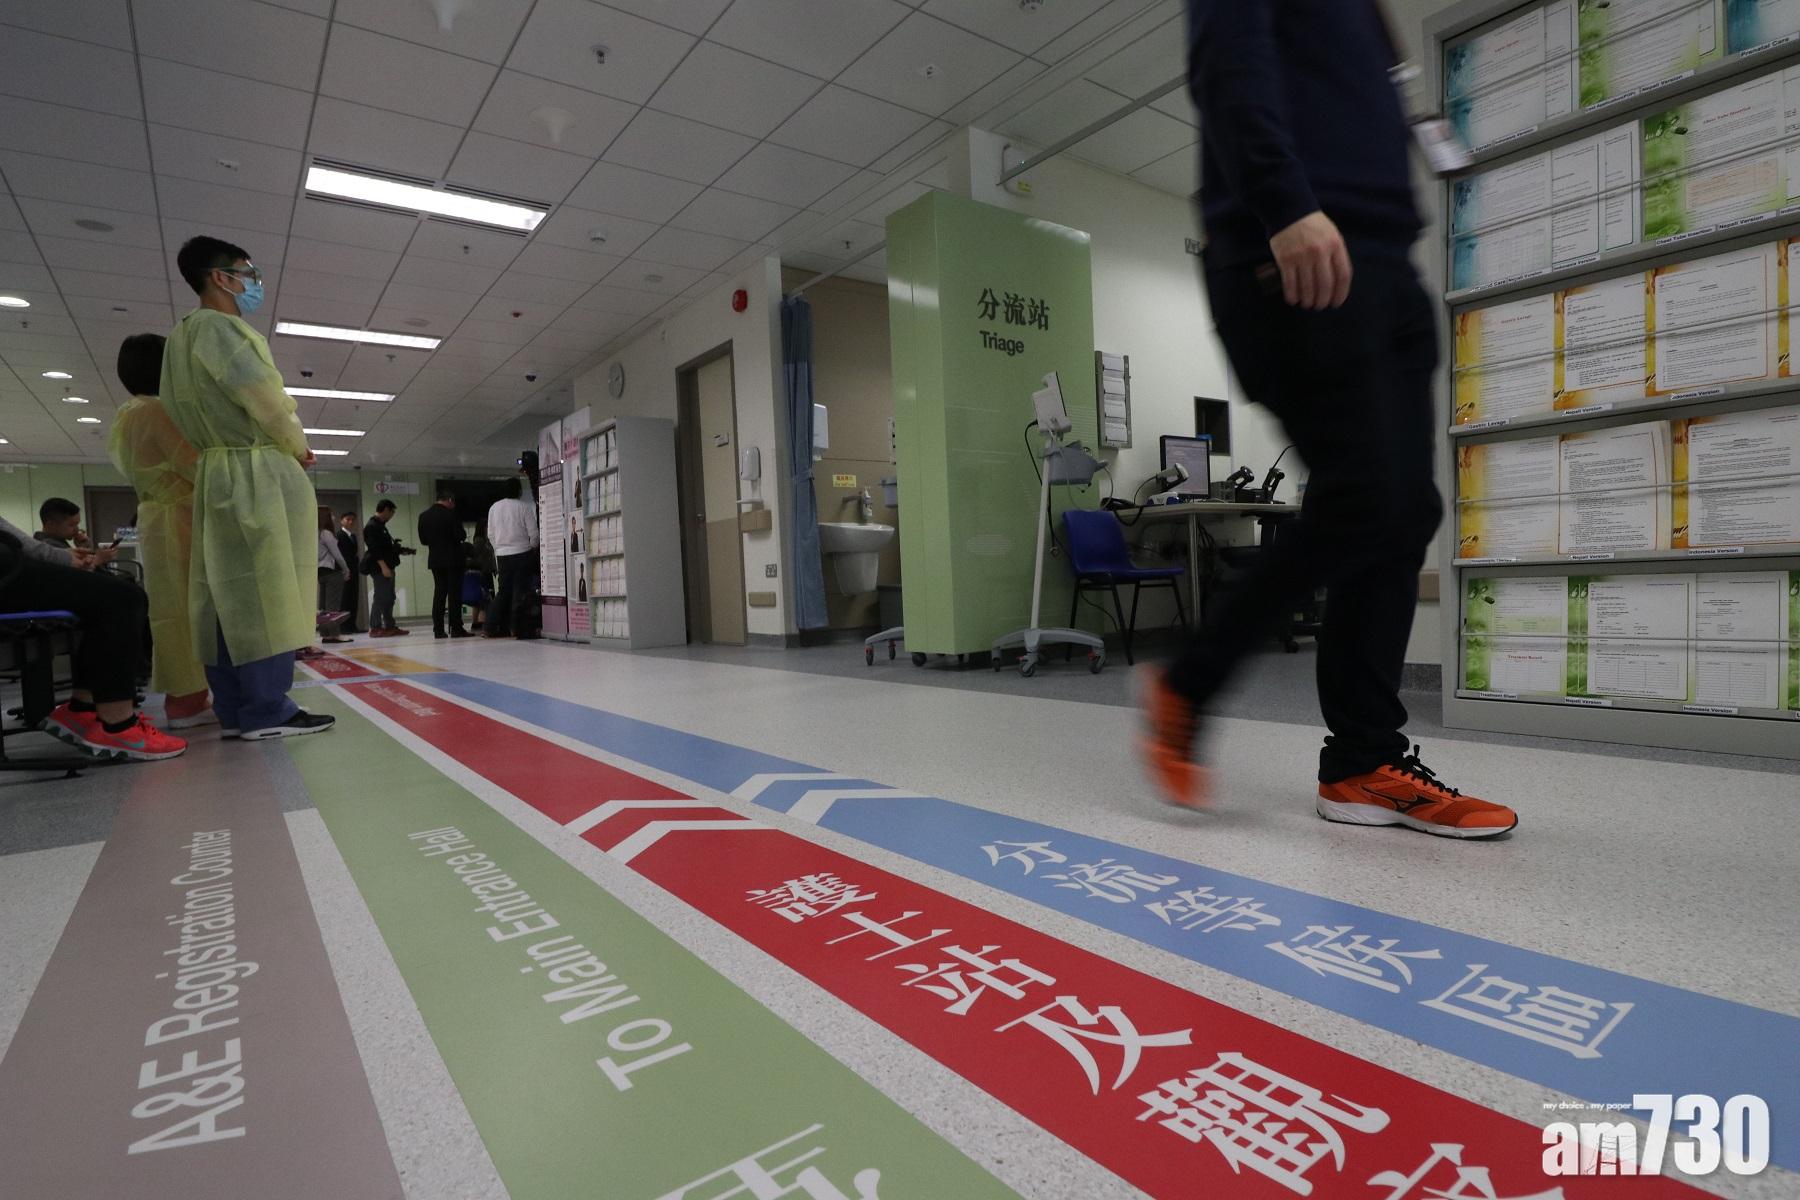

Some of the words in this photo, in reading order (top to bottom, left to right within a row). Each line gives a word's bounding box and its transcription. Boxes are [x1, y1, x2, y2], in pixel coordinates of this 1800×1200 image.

[977, 286, 1050, 331] 分流站
[979, 331, 1025, 357] Triage
[170, 829, 234, 886] Counter
[406, 825, 475, 858] Hall
[445, 851, 562, 943] Entrance
[143, 881, 260, 1047] Registration
[519, 935, 641, 1025] Main
[981, 839, 1635, 1059] 分流等候區
[595, 1017, 693, 1092] To
[127, 1037, 246, 1156] A&E
